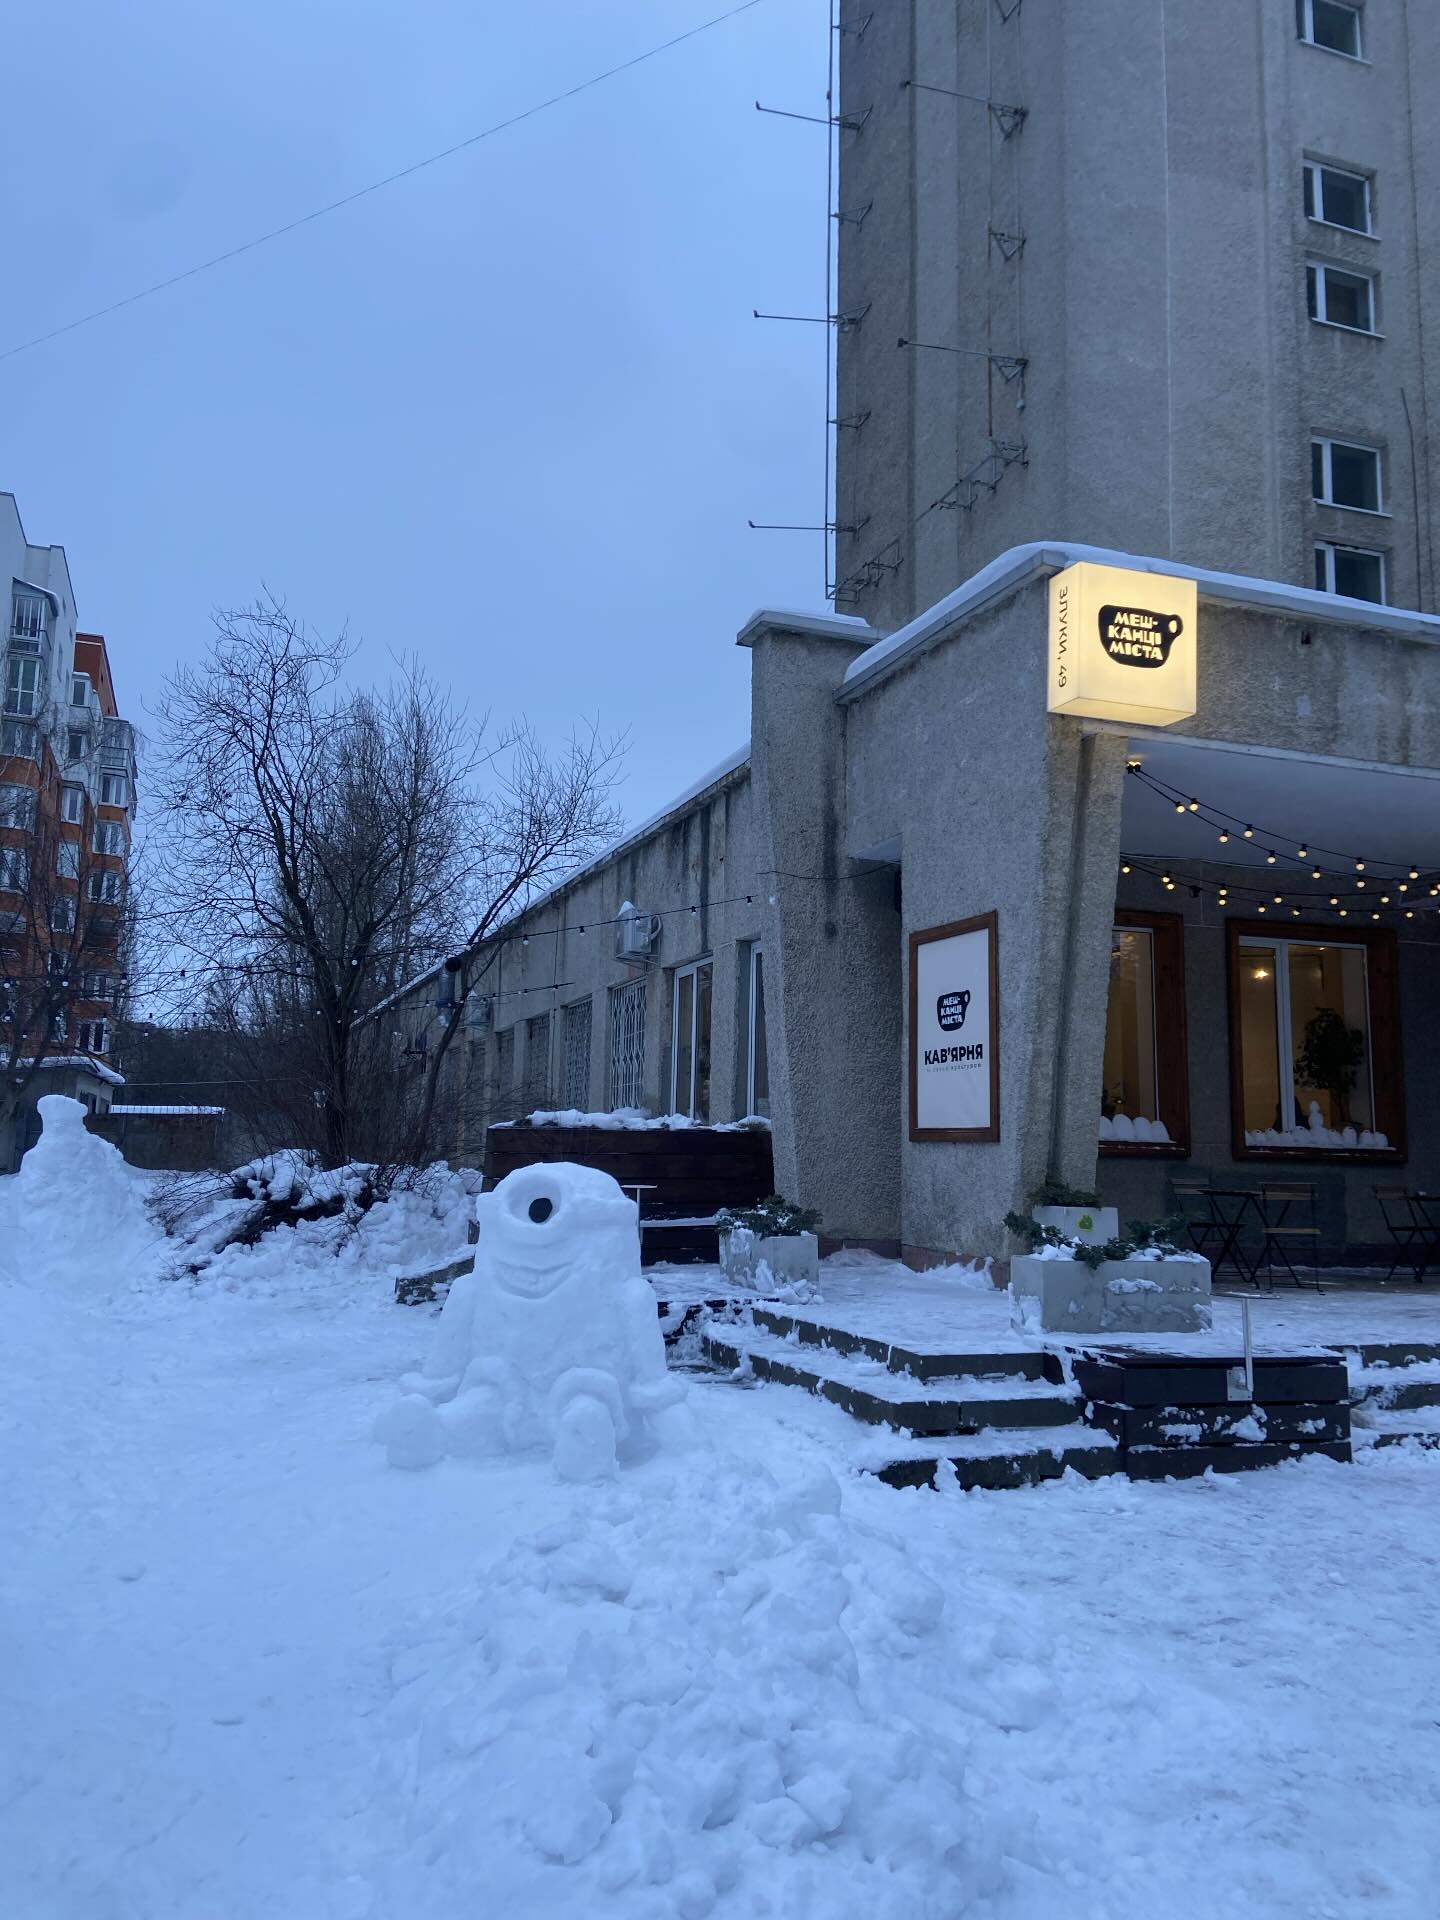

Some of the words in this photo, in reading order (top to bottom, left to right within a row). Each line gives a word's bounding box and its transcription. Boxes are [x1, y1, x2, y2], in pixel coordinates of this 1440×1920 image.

[1114, 612, 1158, 629] МЕШ-
[1108, 625, 1161, 645] КАНЦІ
[1110, 641, 1163, 661] МІСТА
[1058, 665, 1067, 688] 49
[941, 1015, 962, 1025] МІСТА
